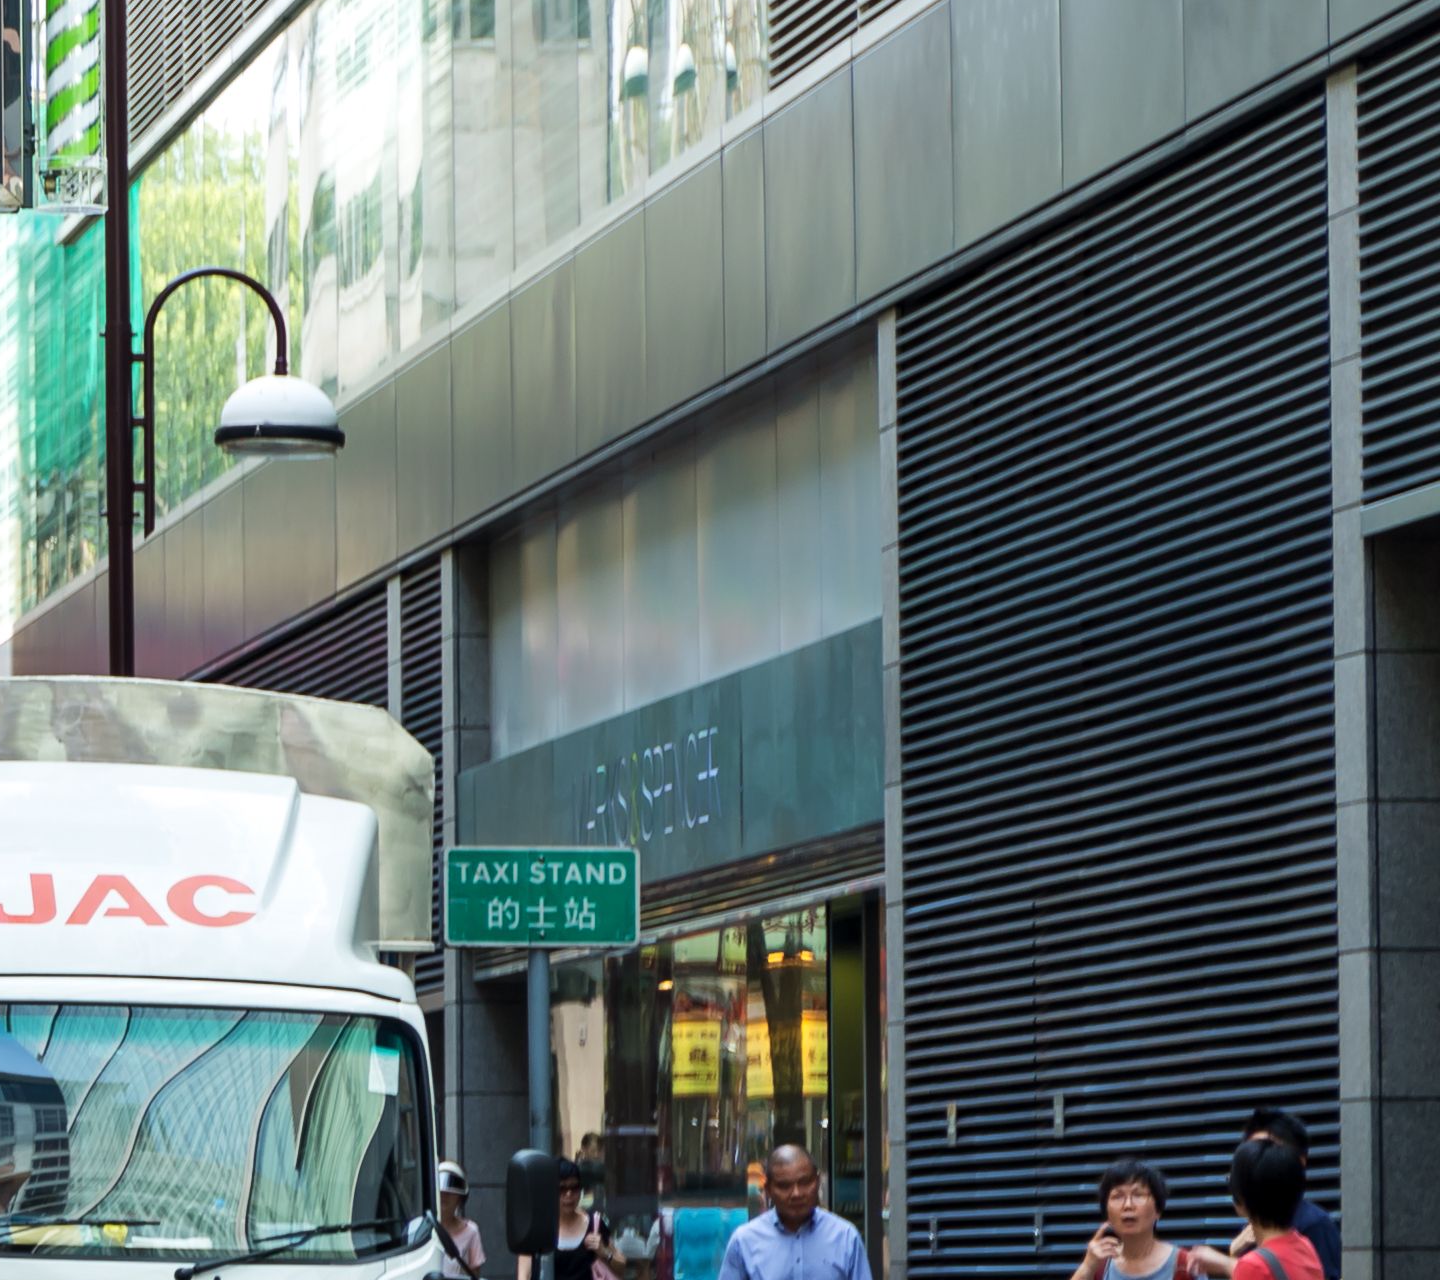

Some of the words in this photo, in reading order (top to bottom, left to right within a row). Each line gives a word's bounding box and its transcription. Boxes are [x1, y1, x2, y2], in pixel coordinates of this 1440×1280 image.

[456, 861, 518, 885] TAXI
[530, 862, 627, 886] STAND
[488, 896, 597, 931] 的士站
